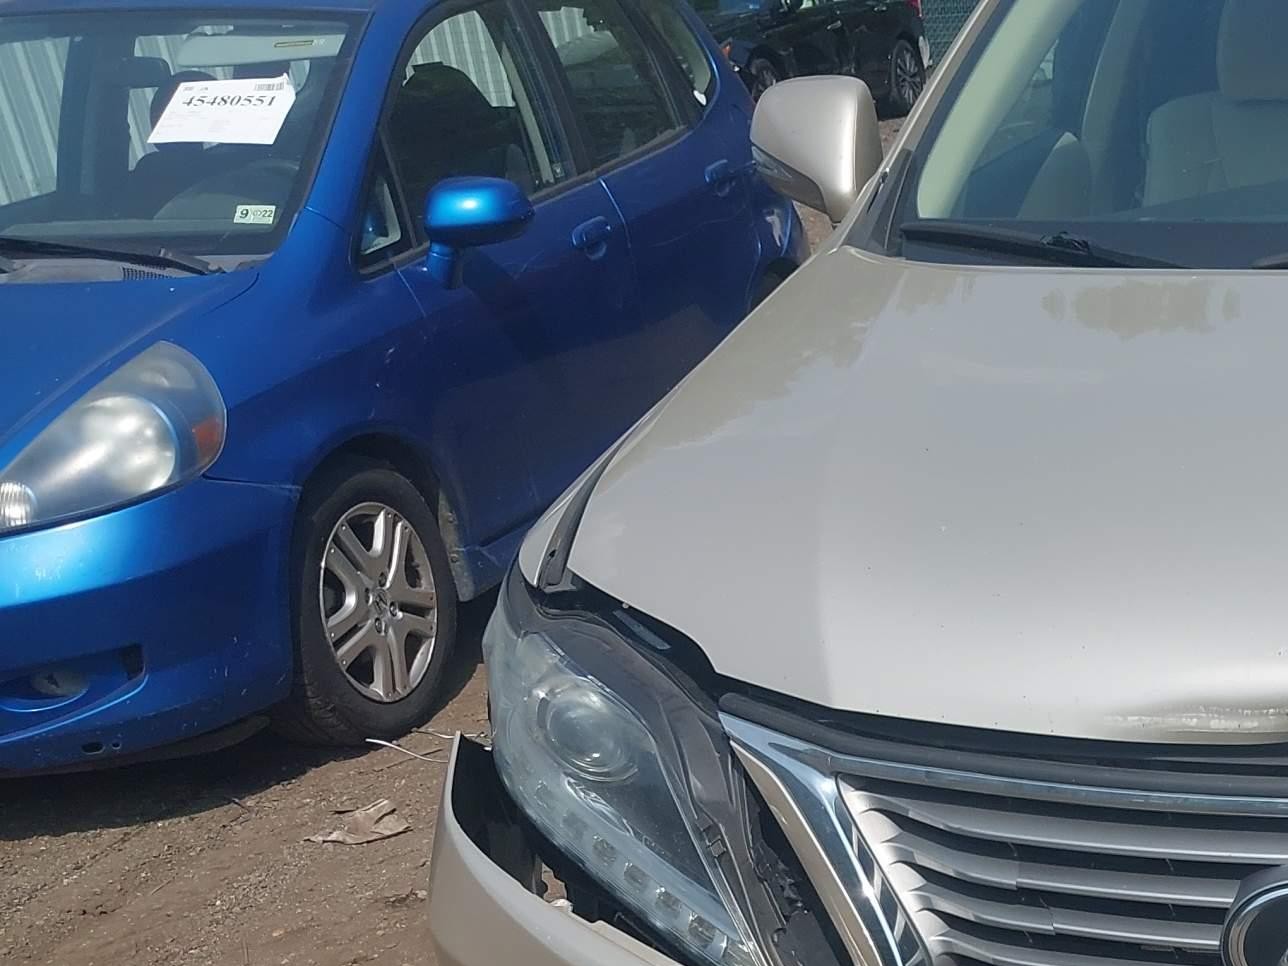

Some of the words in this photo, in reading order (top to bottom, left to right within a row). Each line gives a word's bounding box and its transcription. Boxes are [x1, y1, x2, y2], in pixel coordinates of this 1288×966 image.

[182, 94, 277, 107] 45480551
[239, 208, 249, 218] 9
[262, 209, 273, 218] 22
